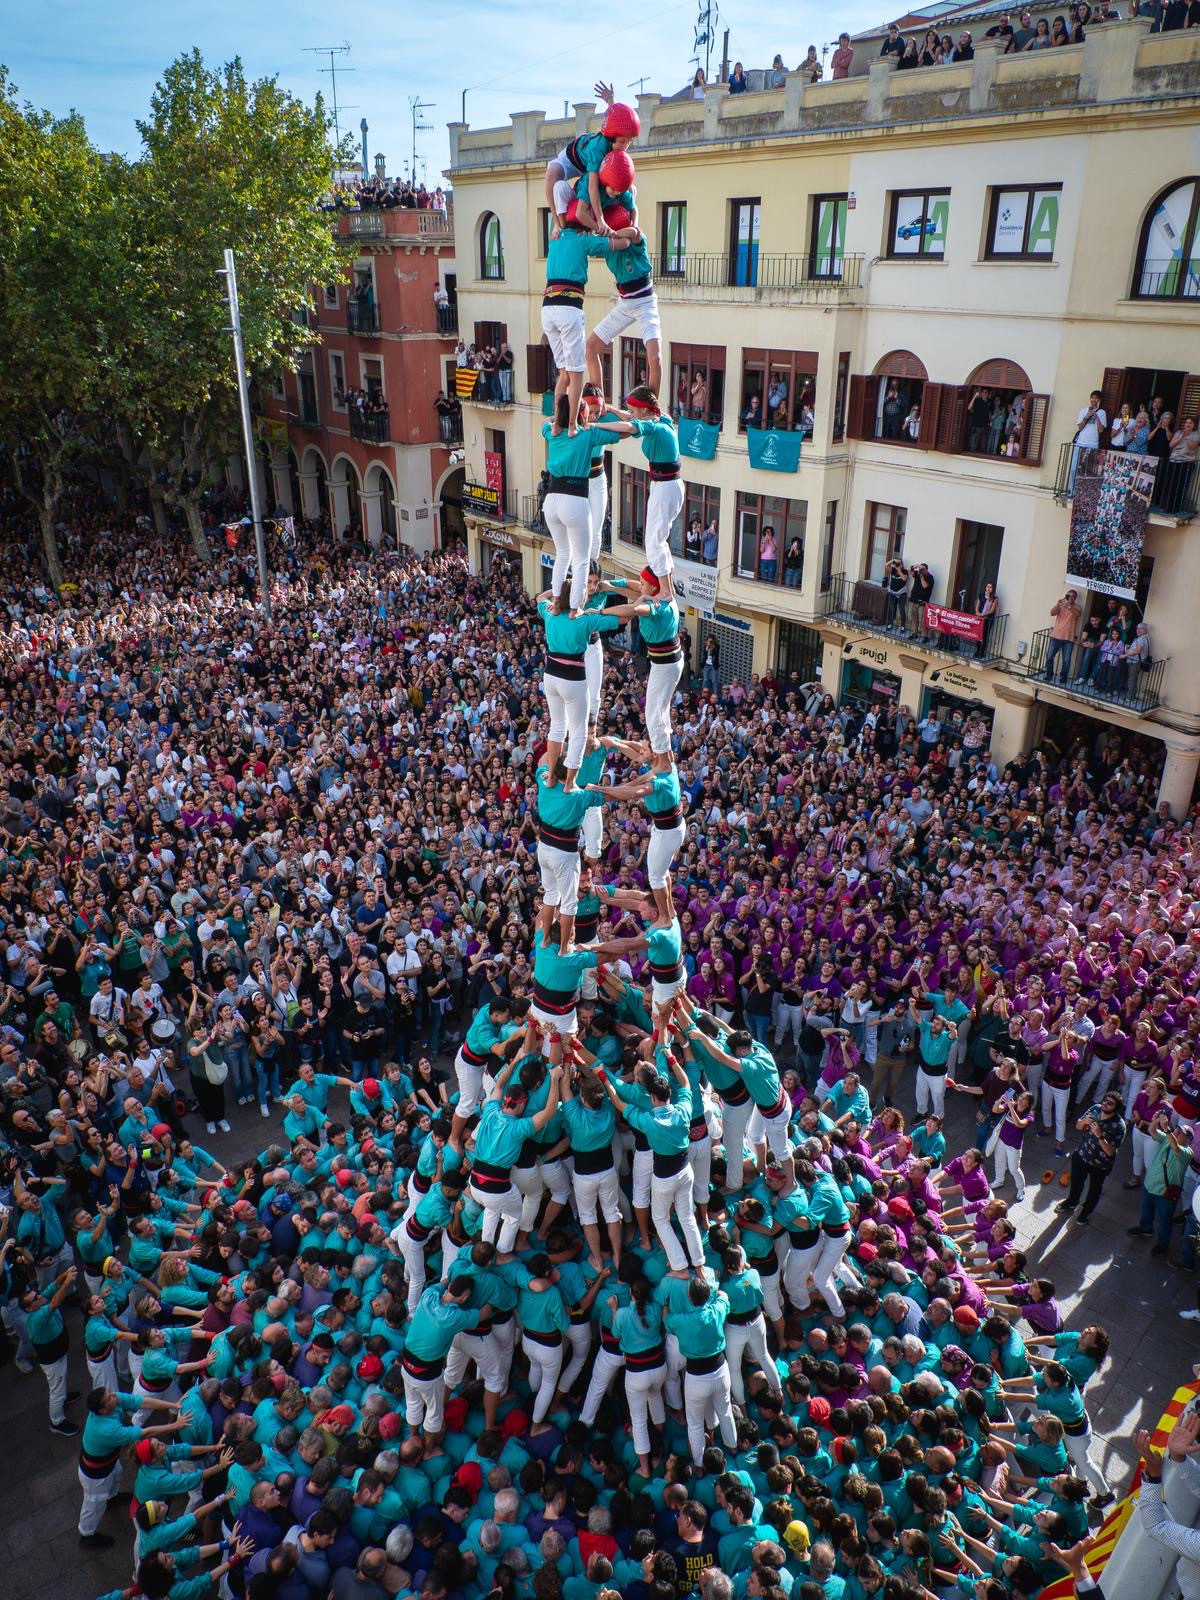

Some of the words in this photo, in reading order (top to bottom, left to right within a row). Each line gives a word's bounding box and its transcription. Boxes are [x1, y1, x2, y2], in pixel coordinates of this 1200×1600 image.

[688, 575, 716, 588] CASTELLERA
[958, 616, 980, 625] casteller
[686, 1554, 713, 1568] HOLD
